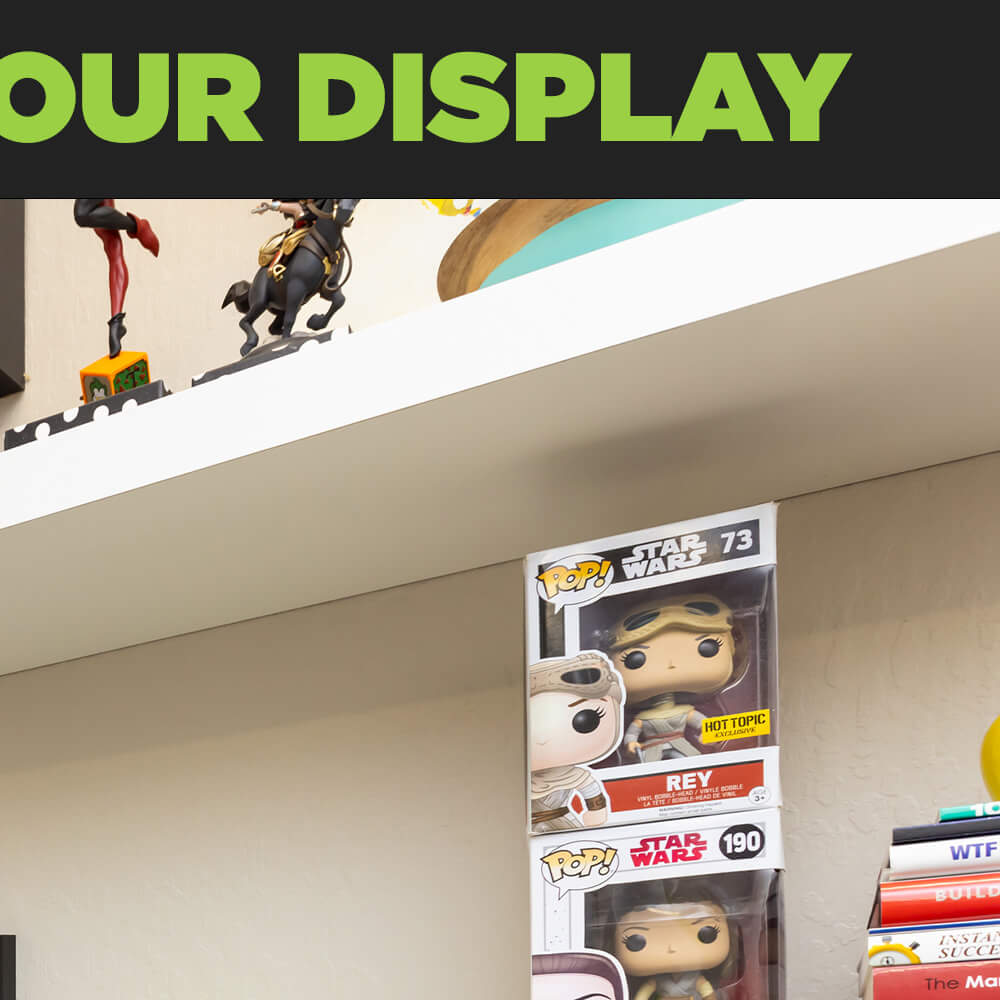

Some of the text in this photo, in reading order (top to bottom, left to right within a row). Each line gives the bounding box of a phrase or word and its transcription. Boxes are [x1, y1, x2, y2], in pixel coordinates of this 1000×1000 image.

[622, 529, 753, 565] STAR 73
[622, 546, 708, 580] WARS
[537, 559, 612, 599] POP!
[705, 713, 766, 732] HOT TOPIC
[666, 770, 712, 792] REY
[630, 831, 761, 855] STAR 190
[950, 842, 998, 861] WTF
[541, 848, 618, 882] POP!
[630, 845, 707, 867] WARS
[925, 977, 960, 990] The
